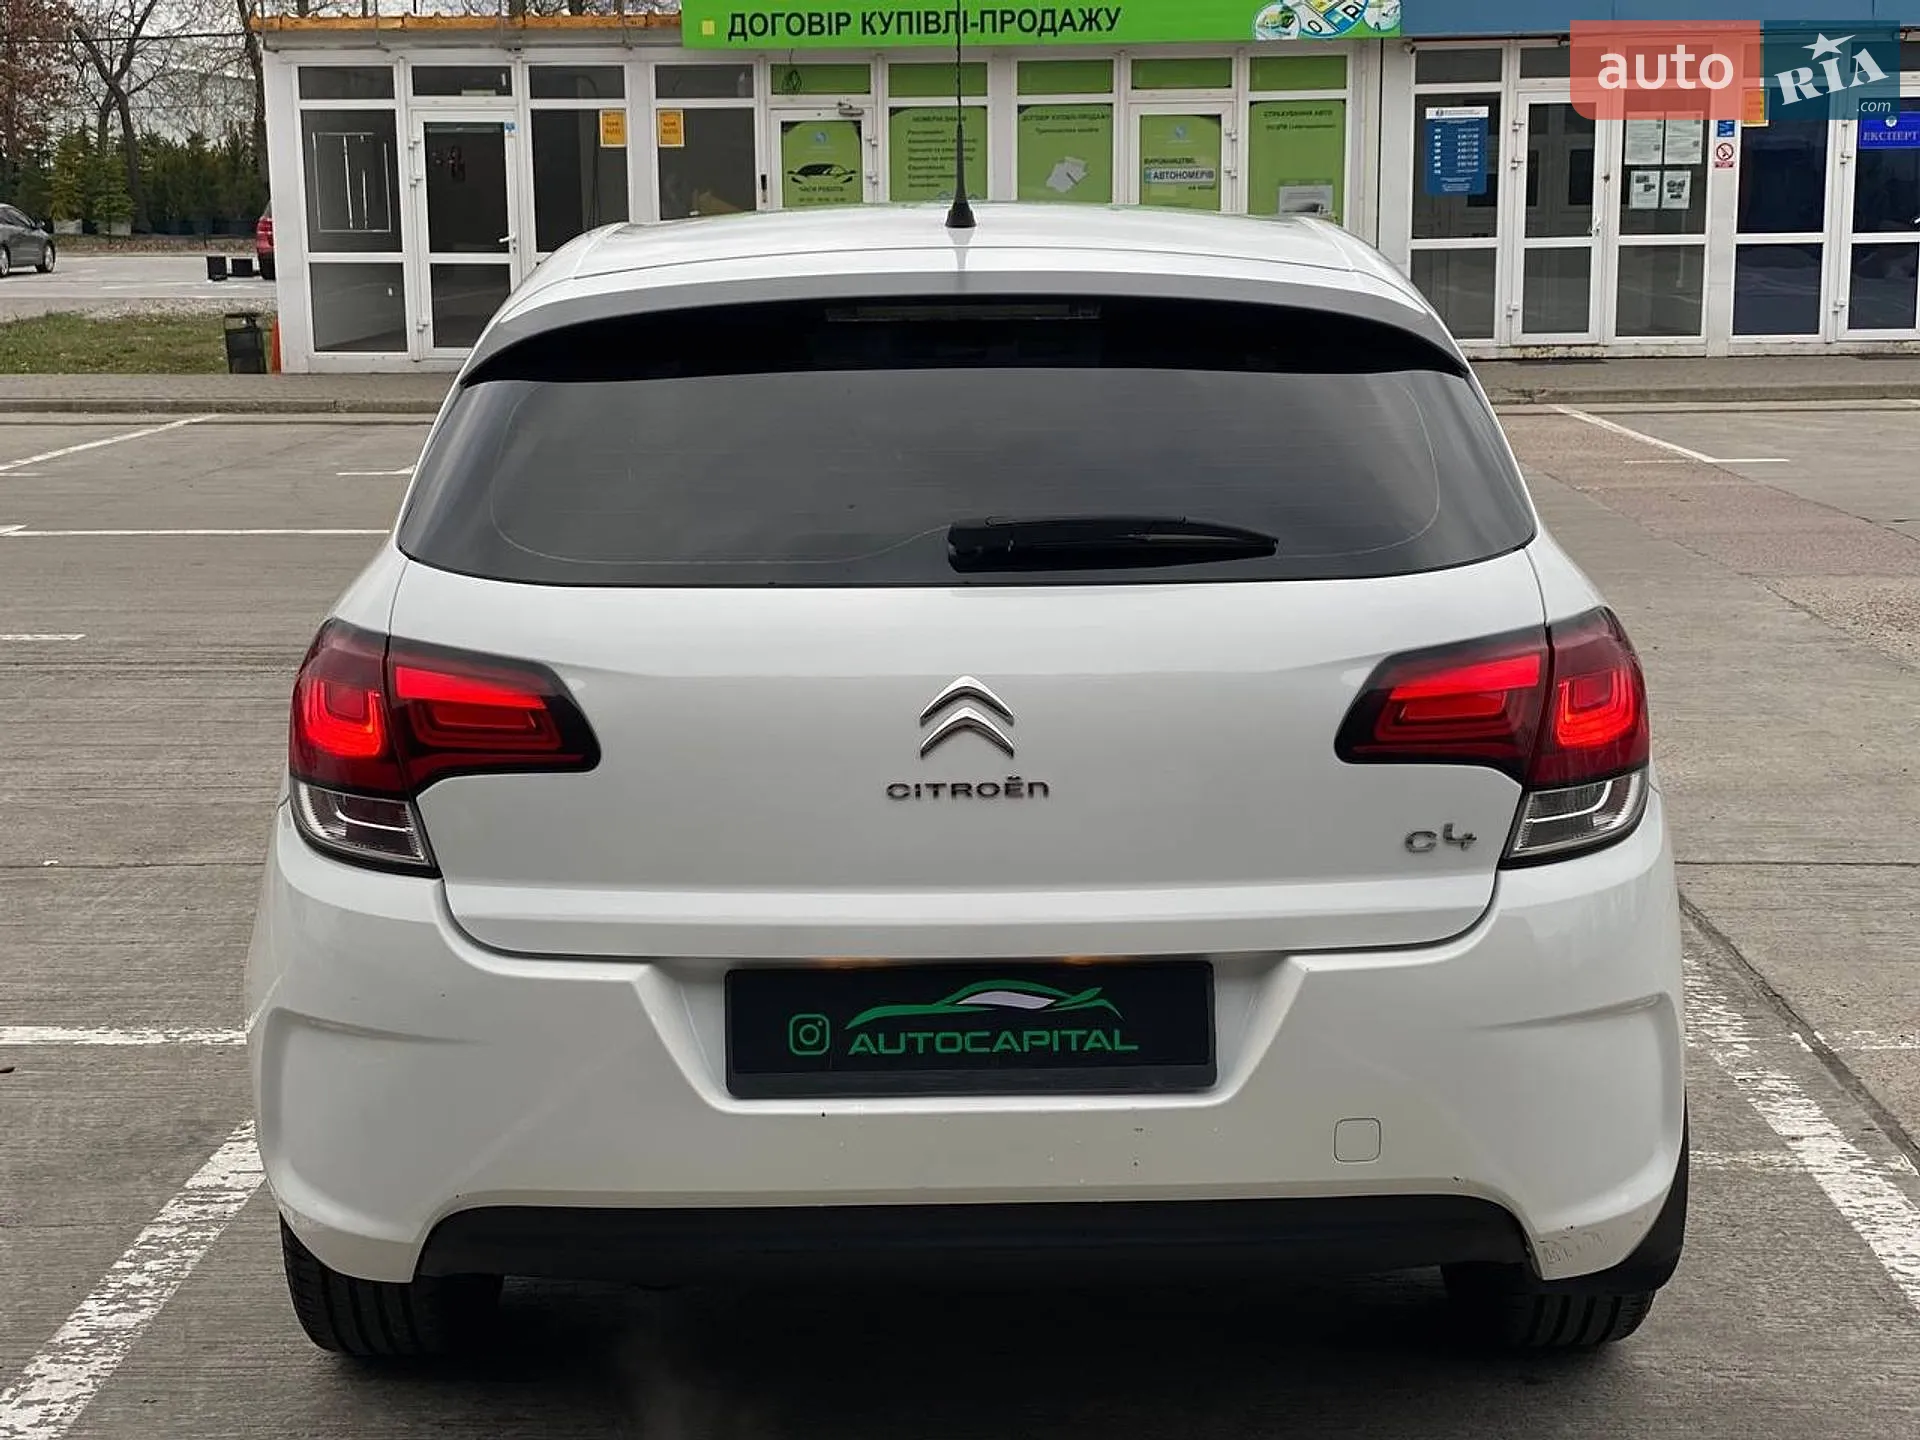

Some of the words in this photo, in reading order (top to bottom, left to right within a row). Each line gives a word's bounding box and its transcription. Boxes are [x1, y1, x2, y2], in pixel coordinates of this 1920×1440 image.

[728, 12, 852, 42] ДОГОВІР
[861, 7, 1122, 37] КУПІВЛІ-ПРОДАЖУ
[1153, 170, 1214, 180] АВТОНОМЕРІВ
[1404, 823, 1477, 853] C4
[848, 1029, 1140, 1056] AUTOCAPITAL
